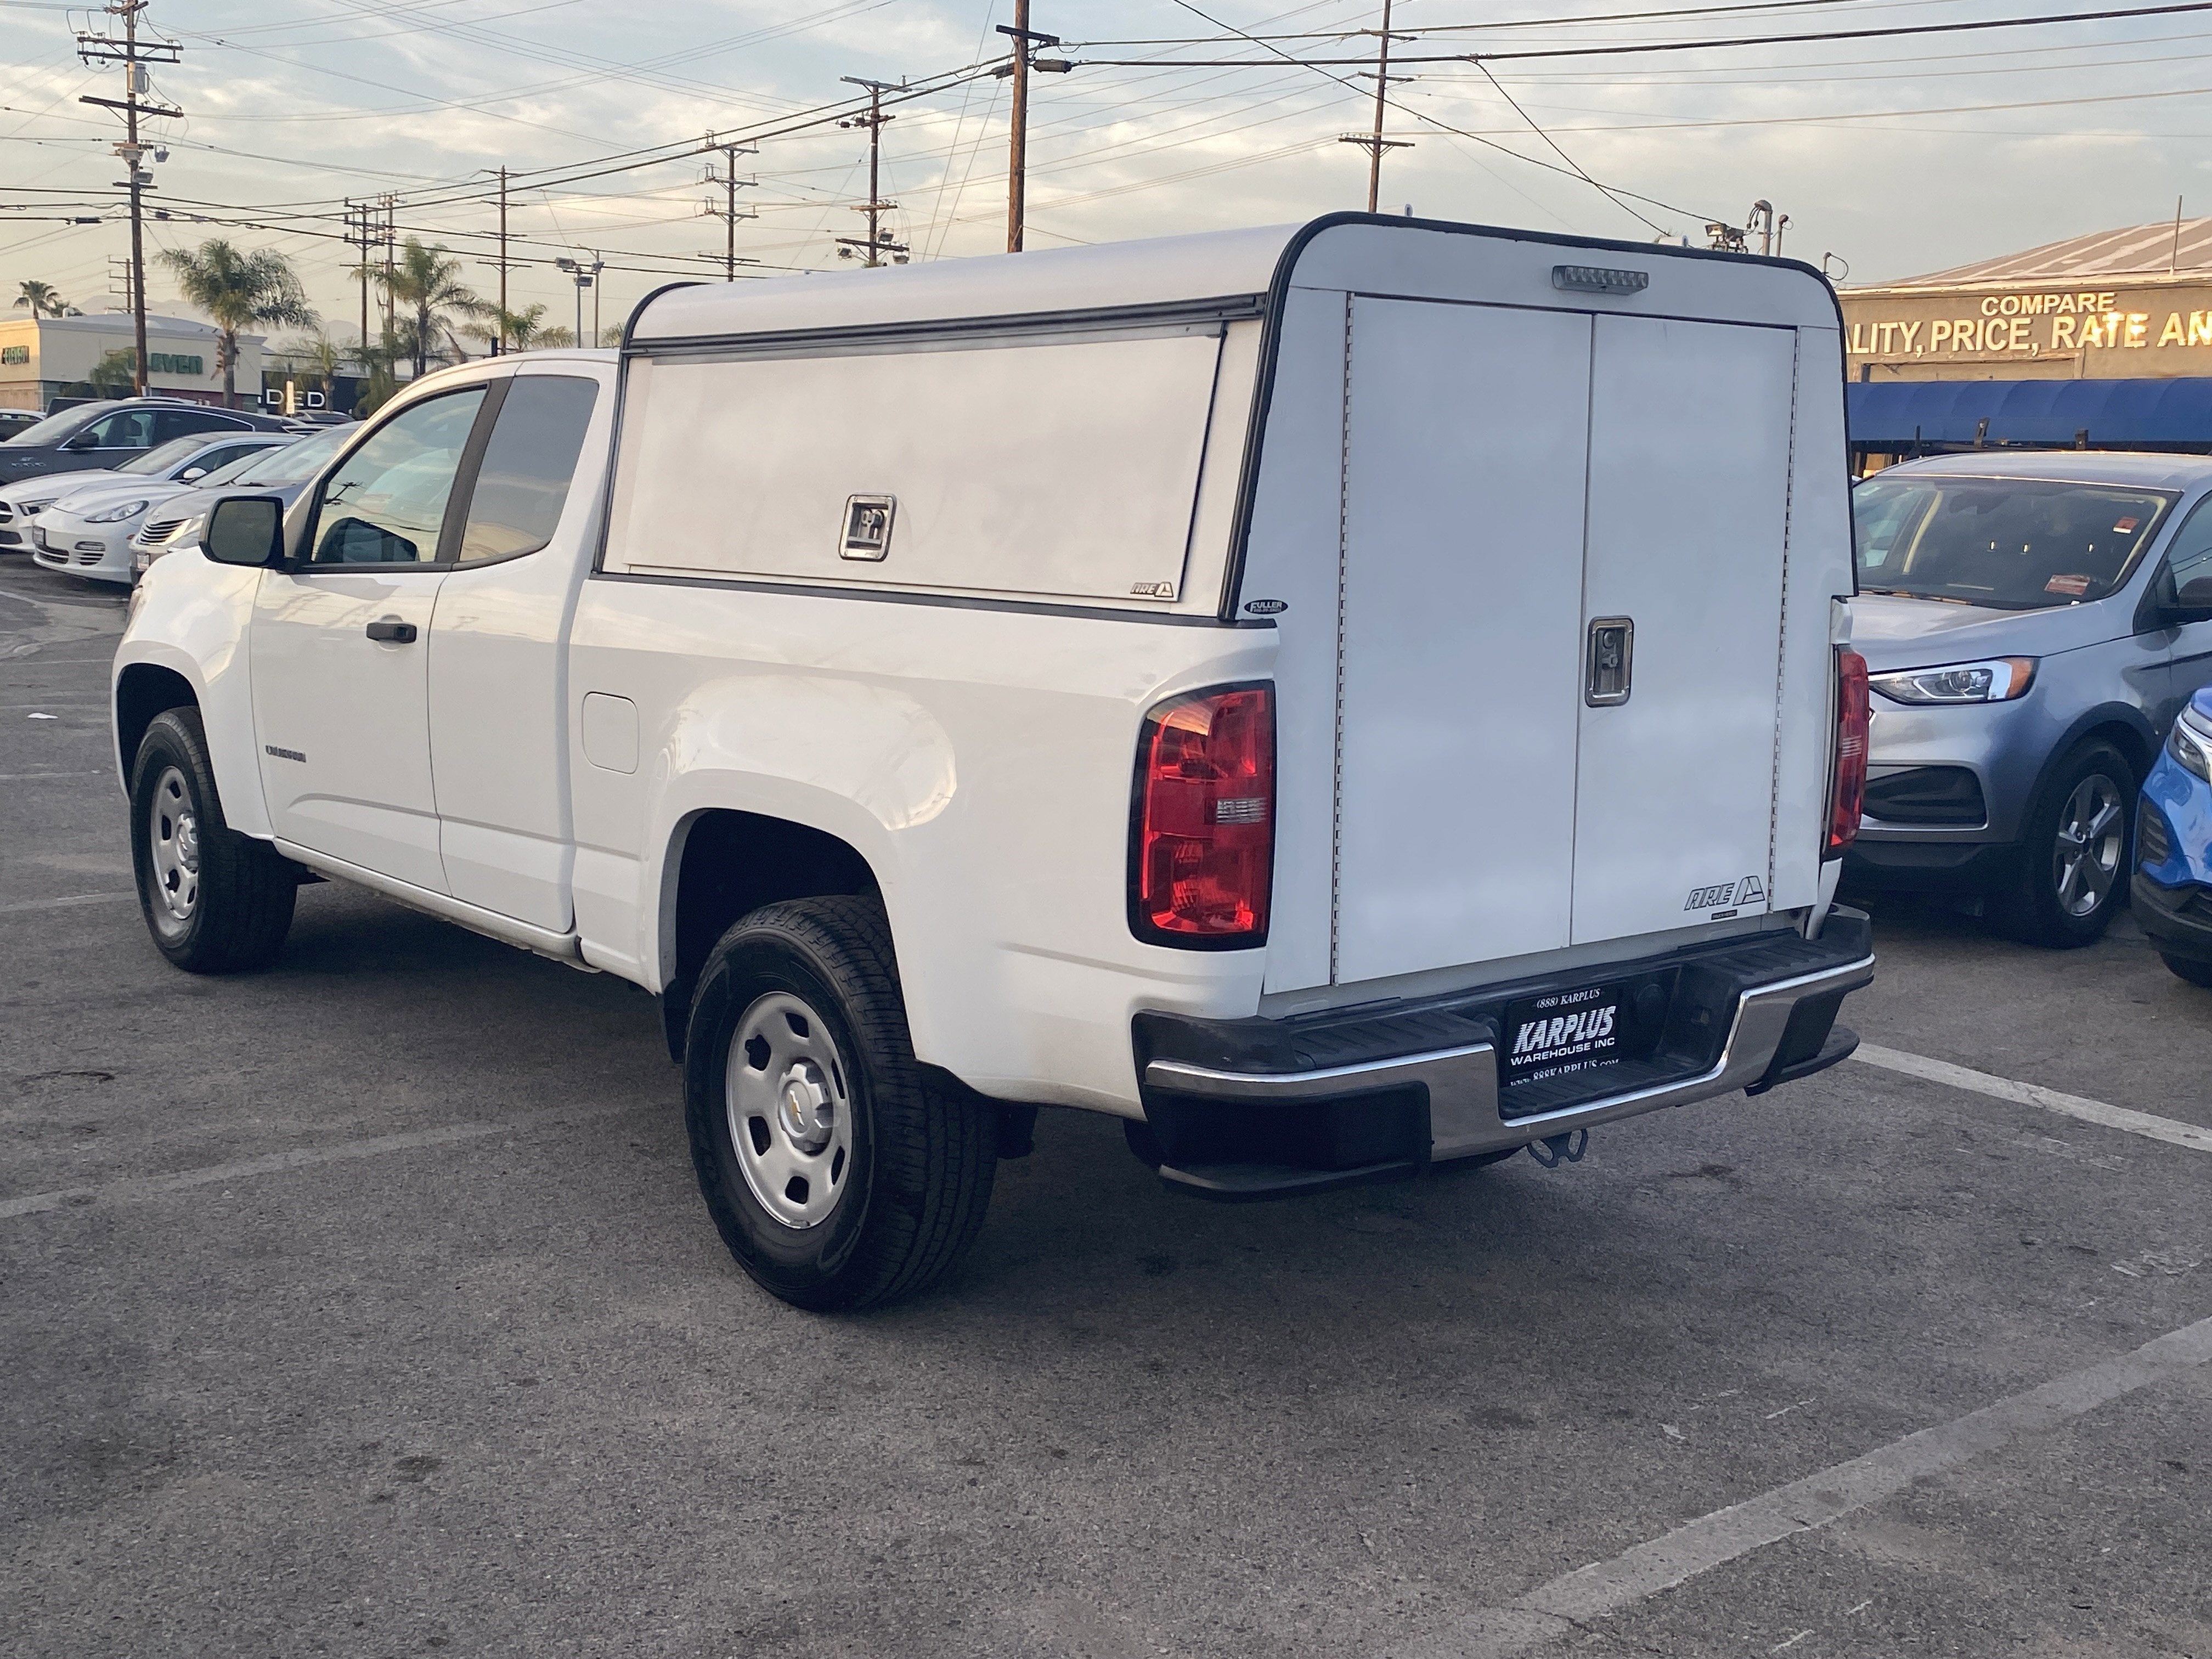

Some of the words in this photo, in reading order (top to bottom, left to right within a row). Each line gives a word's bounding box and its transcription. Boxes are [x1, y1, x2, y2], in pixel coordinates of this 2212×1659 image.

[1981, 292, 2117, 317] COMPARE
[1846, 320, 1925, 358] LITY,
[1930, 317, 2040, 357] PRICE,
[2051, 312, 2149, 349] RATE
[1250, 601, 1283, 612] FULLER
[1683, 882, 1736, 911] ARE
[1537, 997, 1559, 1009] (888)
[1560, 988, 1601, 1006] KARPLUS
[1511, 1005, 1617, 1054] KARPLUS
[1510, 1042, 1592, 1066] WAREHOUSE
[1594, 1037, 1616, 1049] INC
